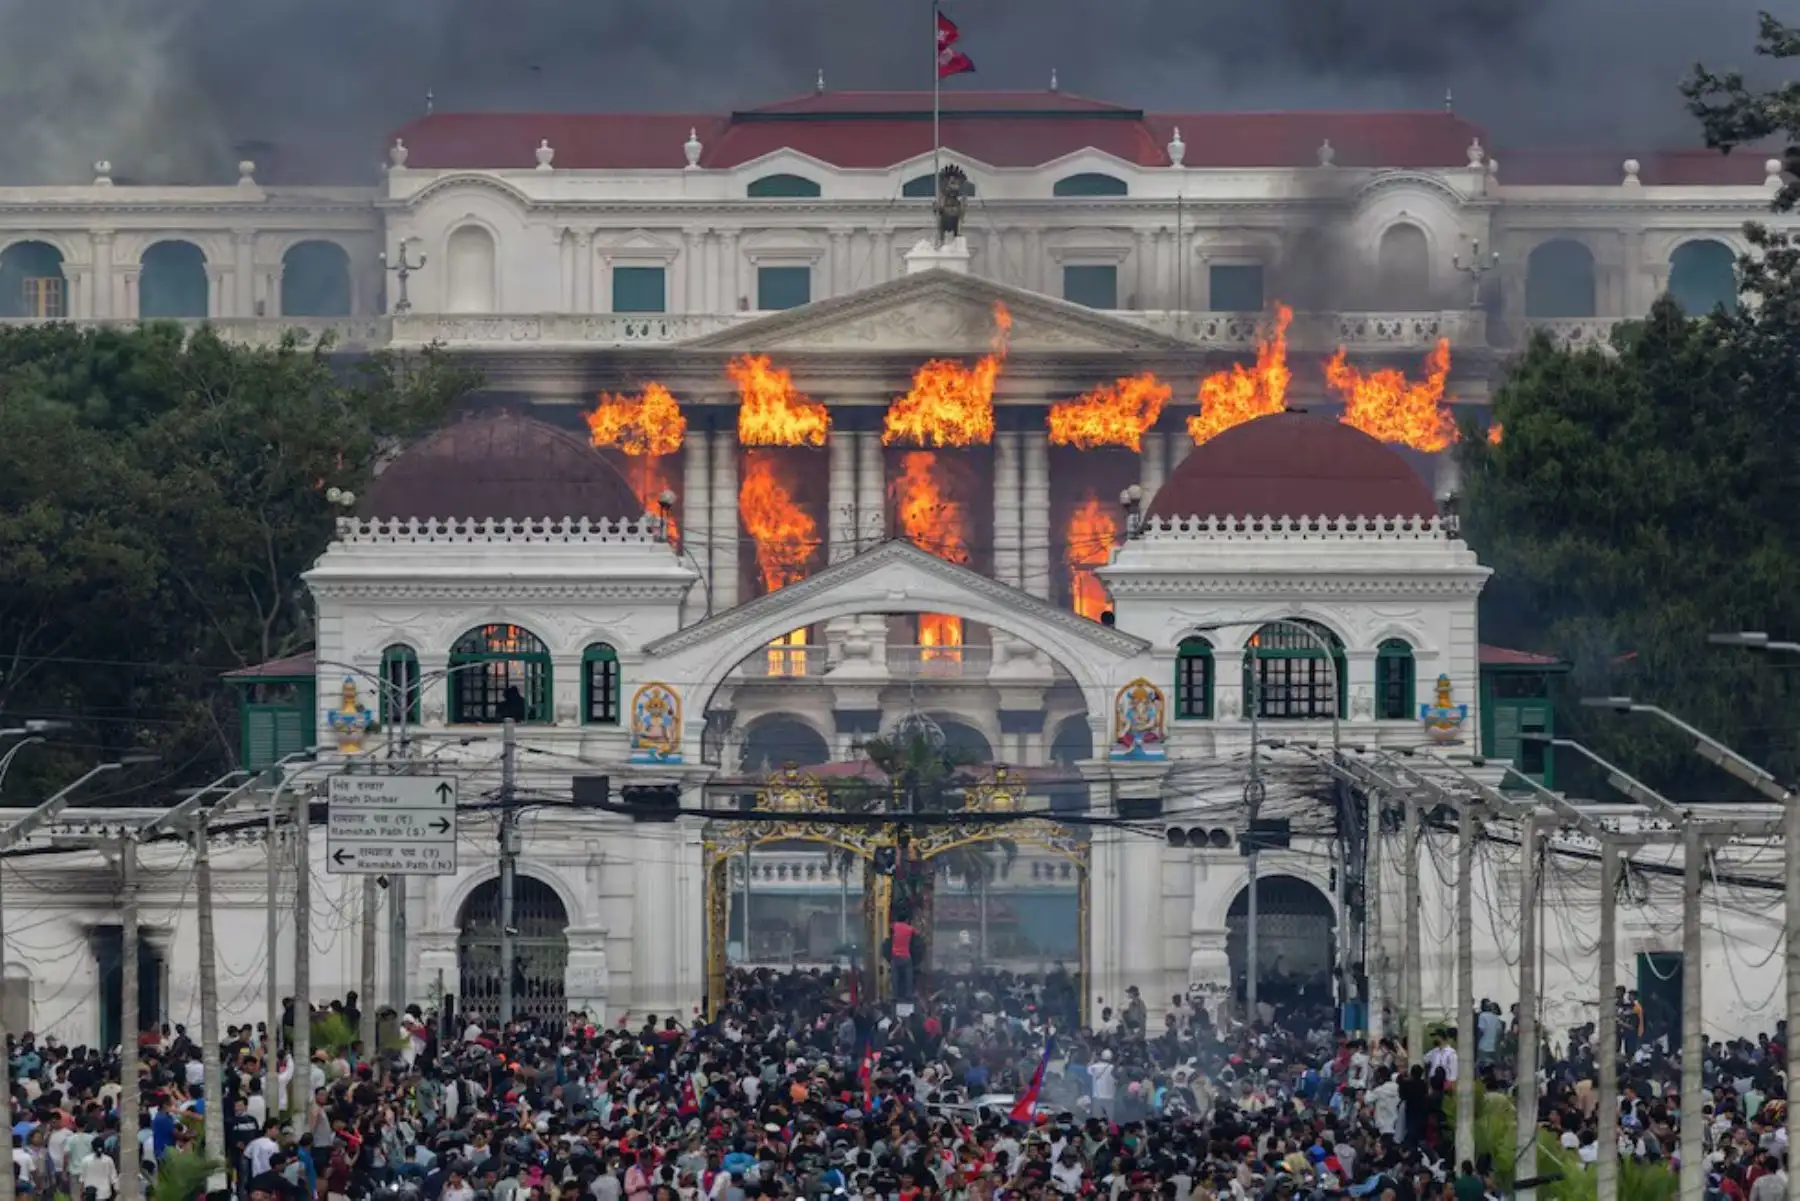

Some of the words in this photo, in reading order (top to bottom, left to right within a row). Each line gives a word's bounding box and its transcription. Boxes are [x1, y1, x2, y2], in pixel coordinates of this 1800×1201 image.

[332, 795, 360, 804] Singh
[380, 827, 403, 836] Path
[405, 860, 428, 870] Path
